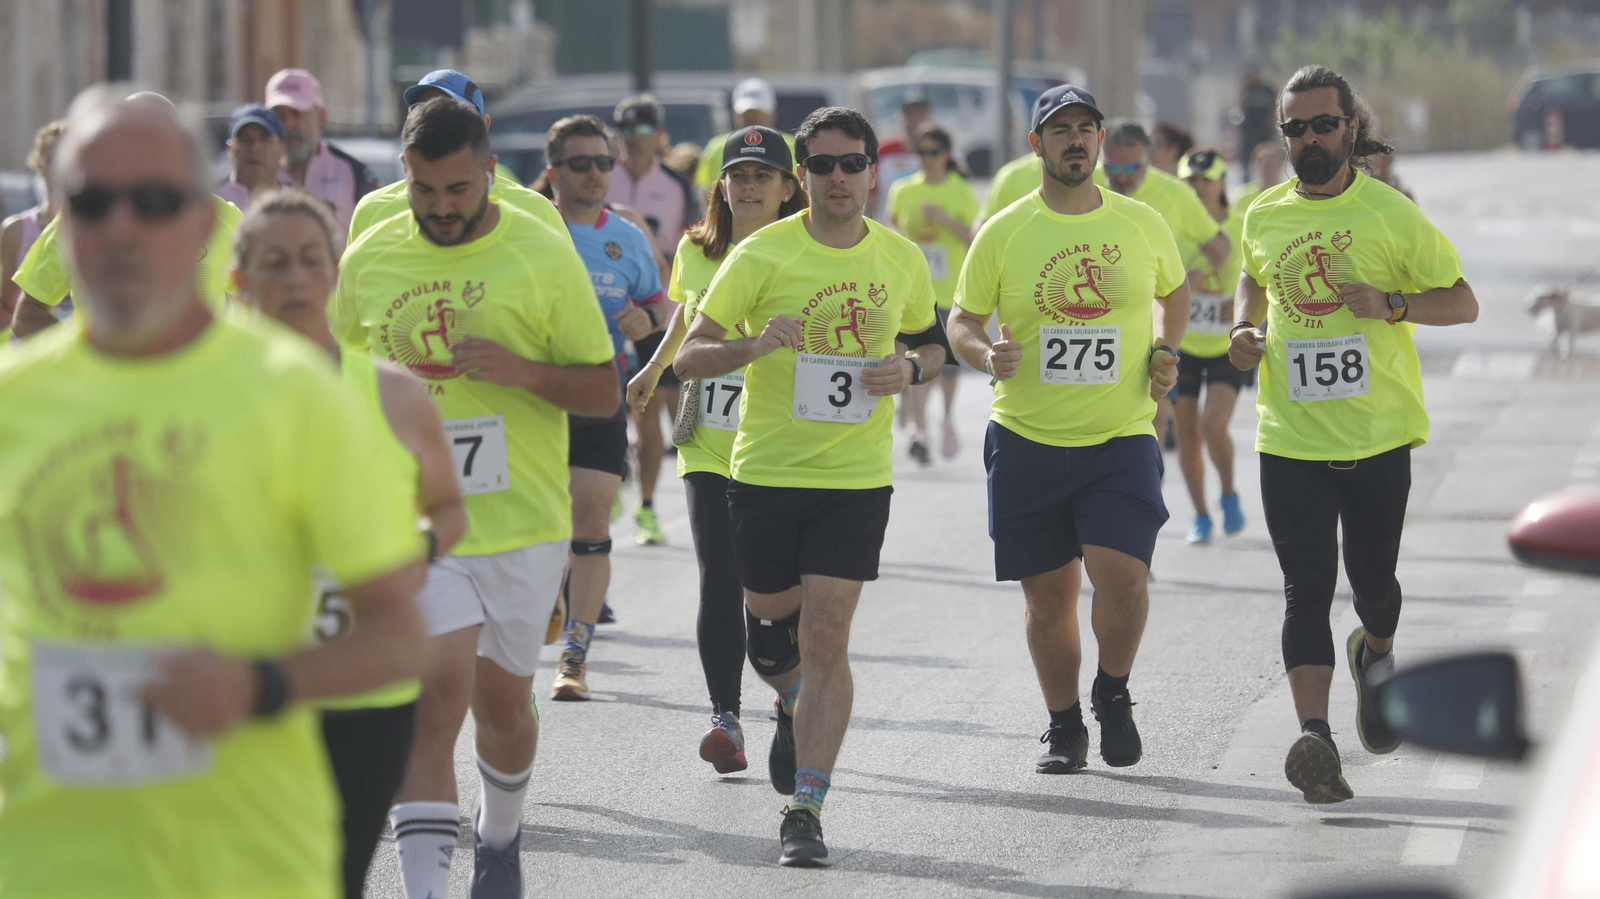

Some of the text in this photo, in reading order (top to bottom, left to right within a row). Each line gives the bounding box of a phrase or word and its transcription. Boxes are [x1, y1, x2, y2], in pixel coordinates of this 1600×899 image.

[1039, 244, 1091, 279] POPULAR
[1275, 231, 1322, 269] POPULAR
[385, 281, 452, 319] POPULAR
[802, 282, 858, 317] POPULAR
[1034, 282, 1066, 324] CARRERA
[1304, 318, 1324, 329] VII
[1344, 337, 1362, 345] APRON
[809, 357, 835, 366] CARRERA
[835, 359, 863, 368] SOLIDARIA
[1046, 338, 1115, 371] 275
[1293, 348, 1364, 387] 158
[705, 381, 743, 417] 17
[828, 371, 853, 408] 3
